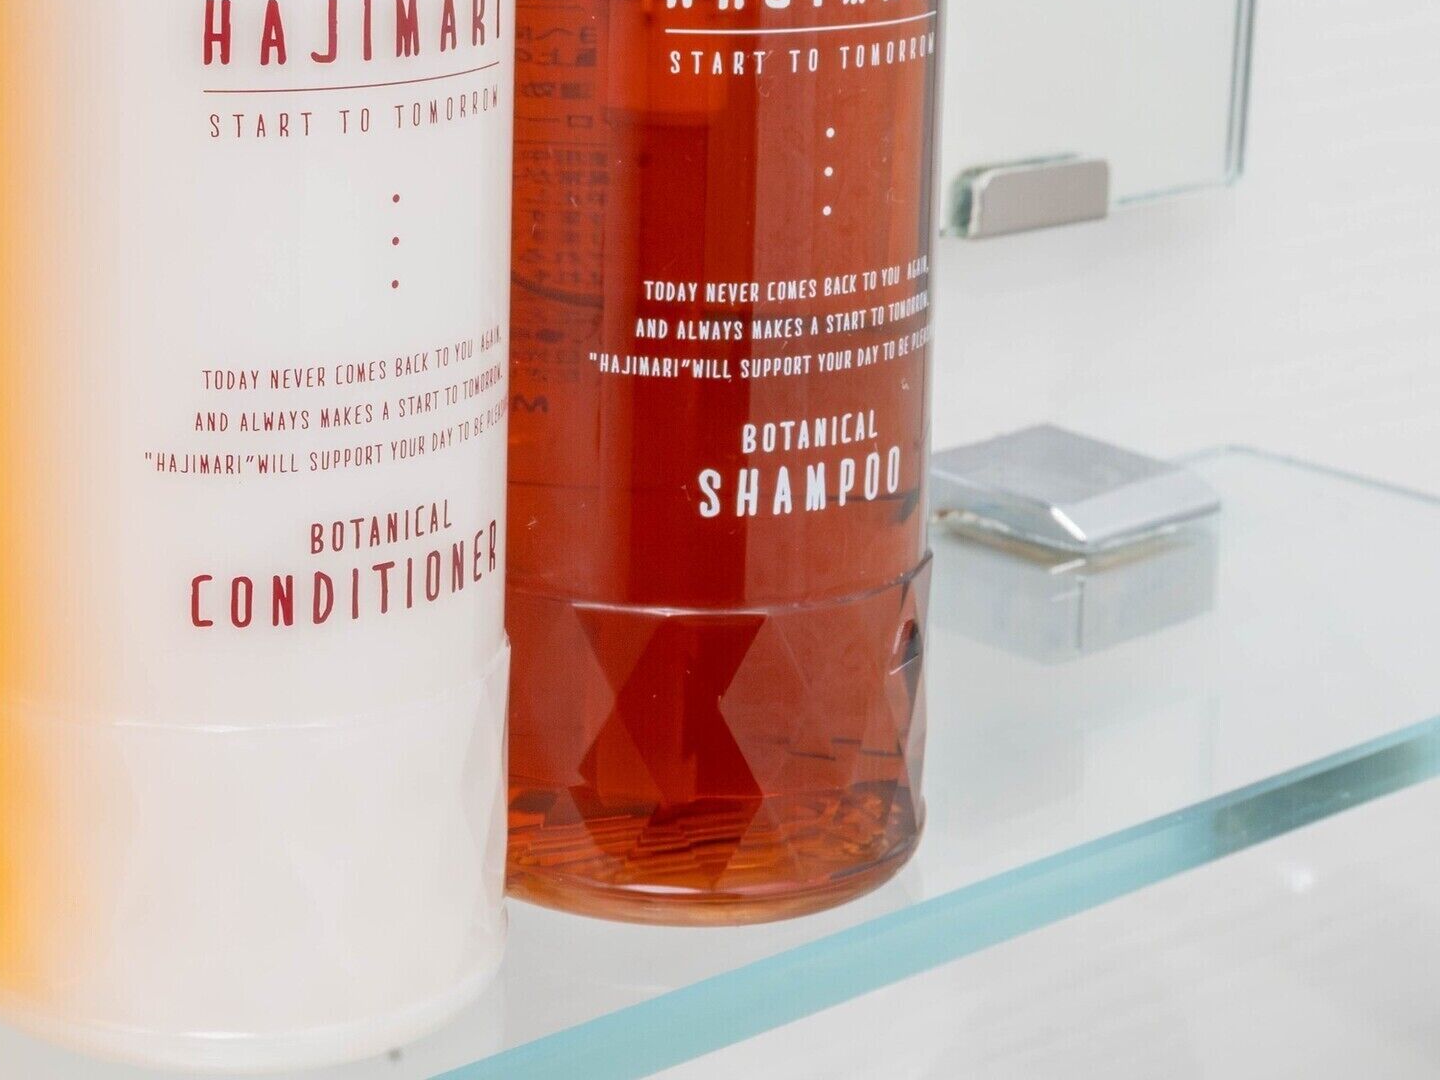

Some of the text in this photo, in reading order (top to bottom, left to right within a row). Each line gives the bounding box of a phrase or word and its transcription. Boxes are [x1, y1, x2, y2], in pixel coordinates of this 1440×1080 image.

[670, 31, 935, 74] START TO TOMORROW
[210, 84, 498, 138] START TO TOMORROW
[644, 281, 698, 302] TODAY
[706, 282, 759, 304] NEVER
[767, 279, 817, 302] COMES
[824, 274, 857, 297] BACK
[862, 271, 877, 291] TO
[881, 266, 900, 286] YOU
[636, 318, 668, 339] AND
[676, 320, 743, 341] ALWAYS
[752, 318, 803, 340] MAKES
[810, 316, 819, 336] A
[826, 309, 866, 334] START
[871, 306, 884, 326] TO
[202, 370, 259, 390] TODAY
[270, 367, 326, 390] NEVER
[335, 360, 387, 385] COMES
[395, 352, 429, 378] BACK
[435, 346, 449, 368] TO
[454, 339, 473, 362] YOU
[740, 355, 812, 379] SUPPORT
[818, 350, 852, 373] YOUR
[857, 345, 878, 367] DAY
[883, 341, 895, 360] TO
[899, 335, 909, 356] BE
[195, 411, 229, 432] AND
[240, 410, 310, 432] ALWAYS
[320, 404, 374, 428] MAKES
[382, 401, 390, 421] A
[398, 391, 439, 418] START
[445, 385, 458, 405] TO
[742, 410, 879, 454] BOTANICAL
[309, 444, 383, 472] SUPPORT
[390, 435, 425, 460] YOUR
[432, 427, 453, 452] DAY
[458, 421, 470, 443] TO
[474, 414, 485, 436] BE
[698, 446, 901, 518] SHAMPOO
[310, 499, 452, 555] BOTANICAL
[191, 519, 497, 628] CONDITIONER
